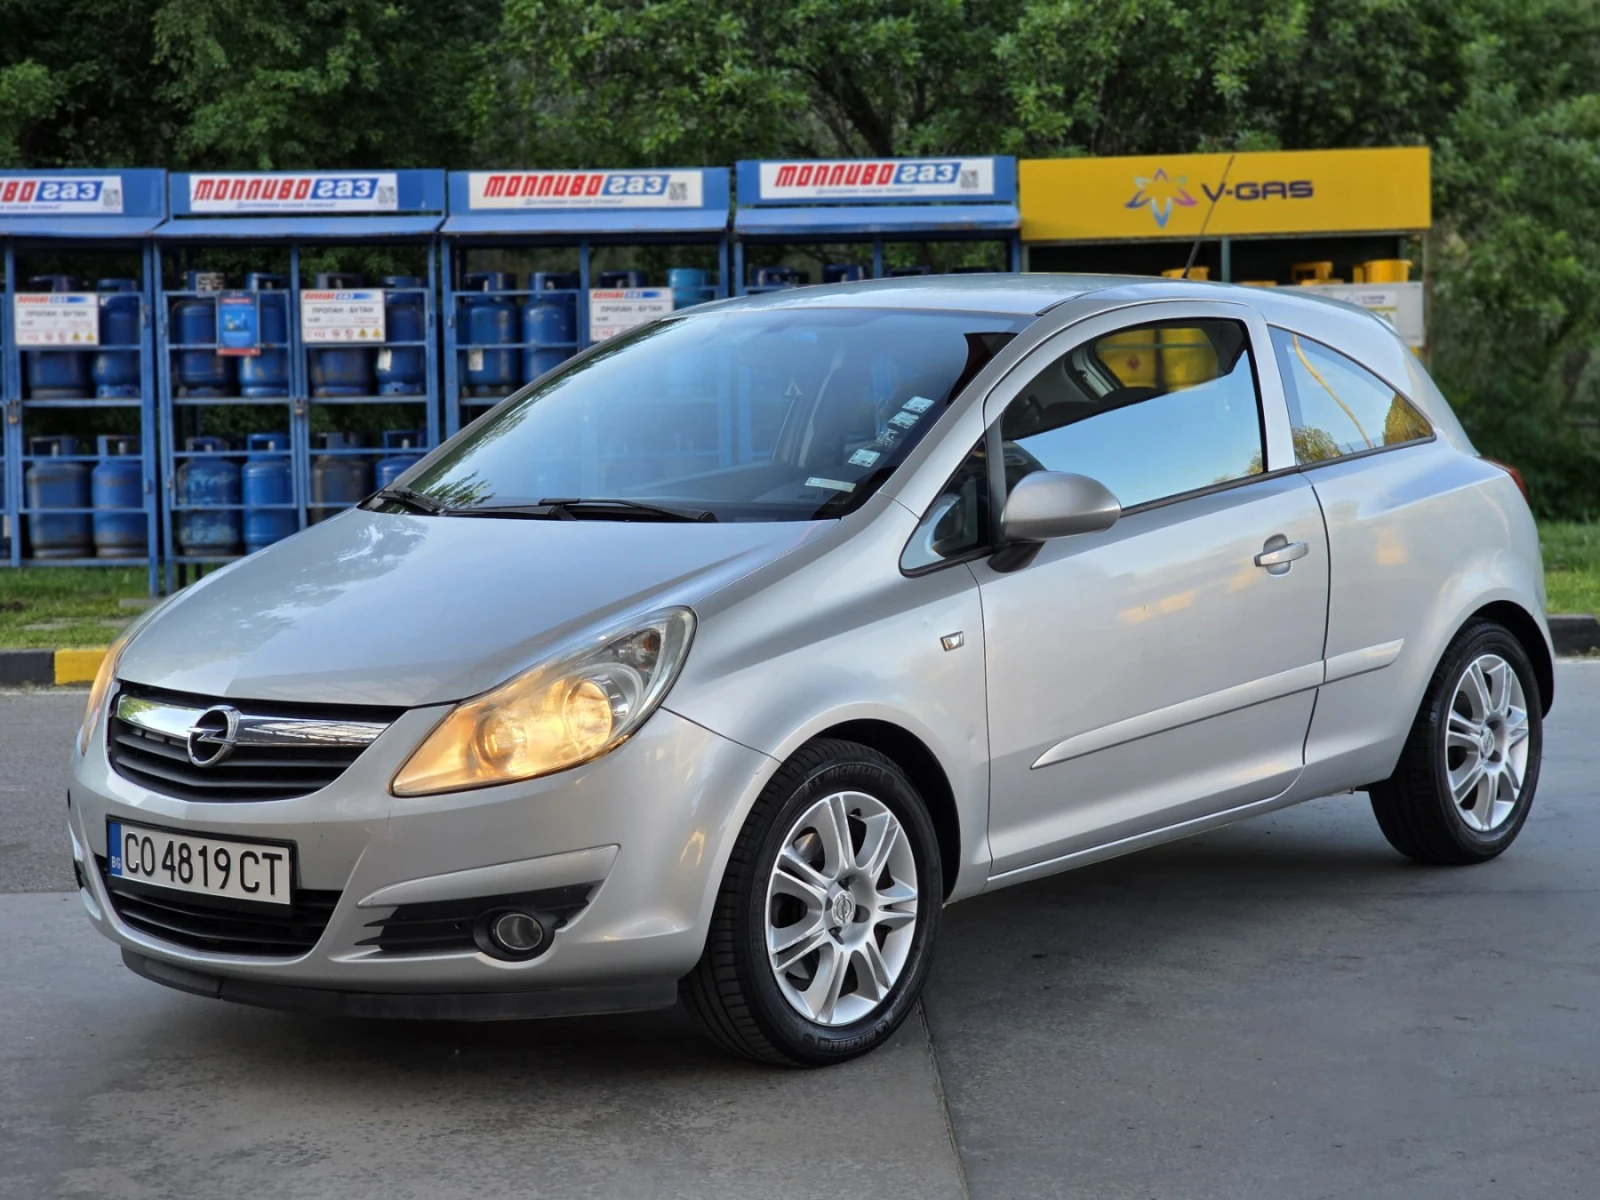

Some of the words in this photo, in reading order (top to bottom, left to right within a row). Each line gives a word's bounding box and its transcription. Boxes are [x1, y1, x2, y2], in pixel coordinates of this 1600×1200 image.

[1201, 181, 1314, 203] V-GAS
[111, 855, 122, 869] BG
[125, 832, 156, 876] CO
[161, 840, 232, 889] 4819
[239, 850, 283, 896] CT
